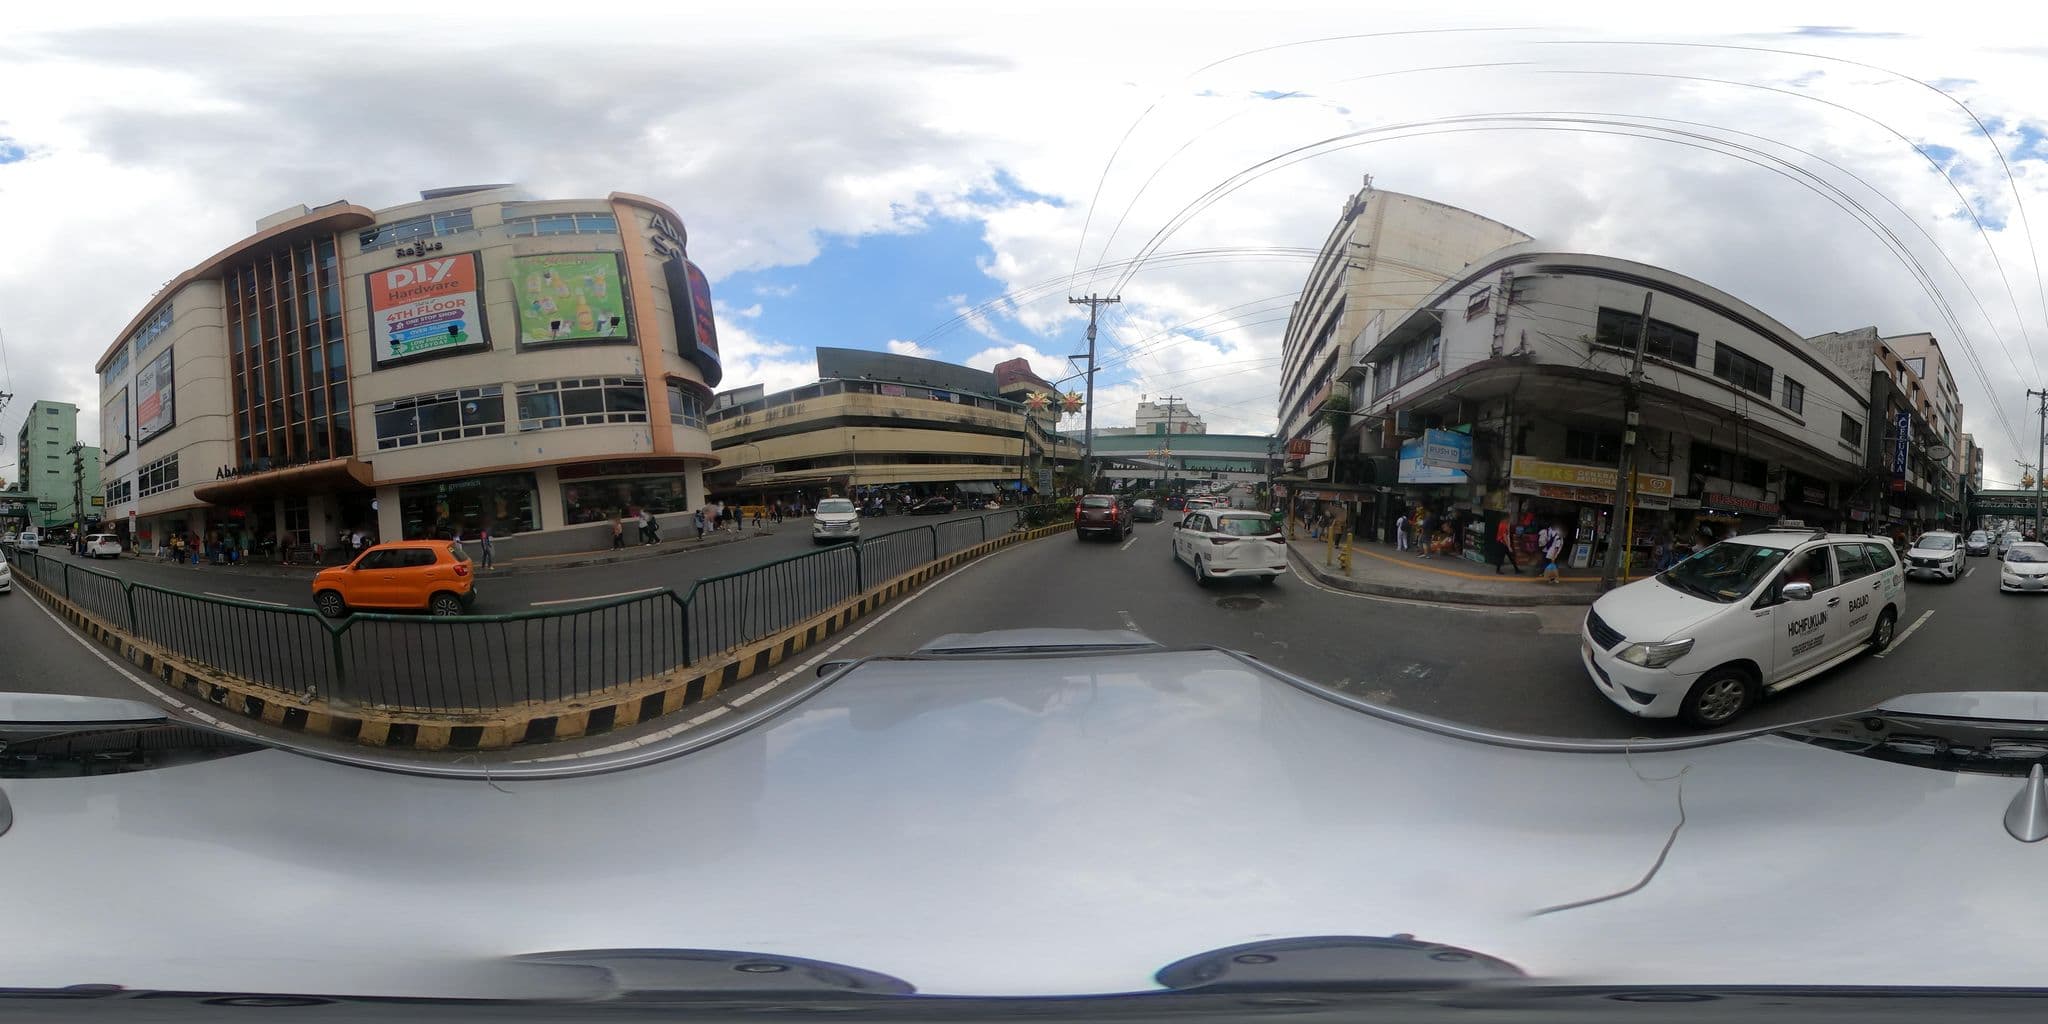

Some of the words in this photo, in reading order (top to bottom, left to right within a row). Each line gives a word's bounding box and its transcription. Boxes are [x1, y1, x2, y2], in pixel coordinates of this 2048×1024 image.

[389, 280, 460, 301] Hardware
[386, 310, 414, 322] 4TH
[417, 298, 467, 316] FLOOR
[420, 313, 439, 323] STOP
[438, 310, 457, 319] SHOP
[1429, 446, 1449, 456] RUSH
[1849, 594, 1869, 612] BAGUIO
